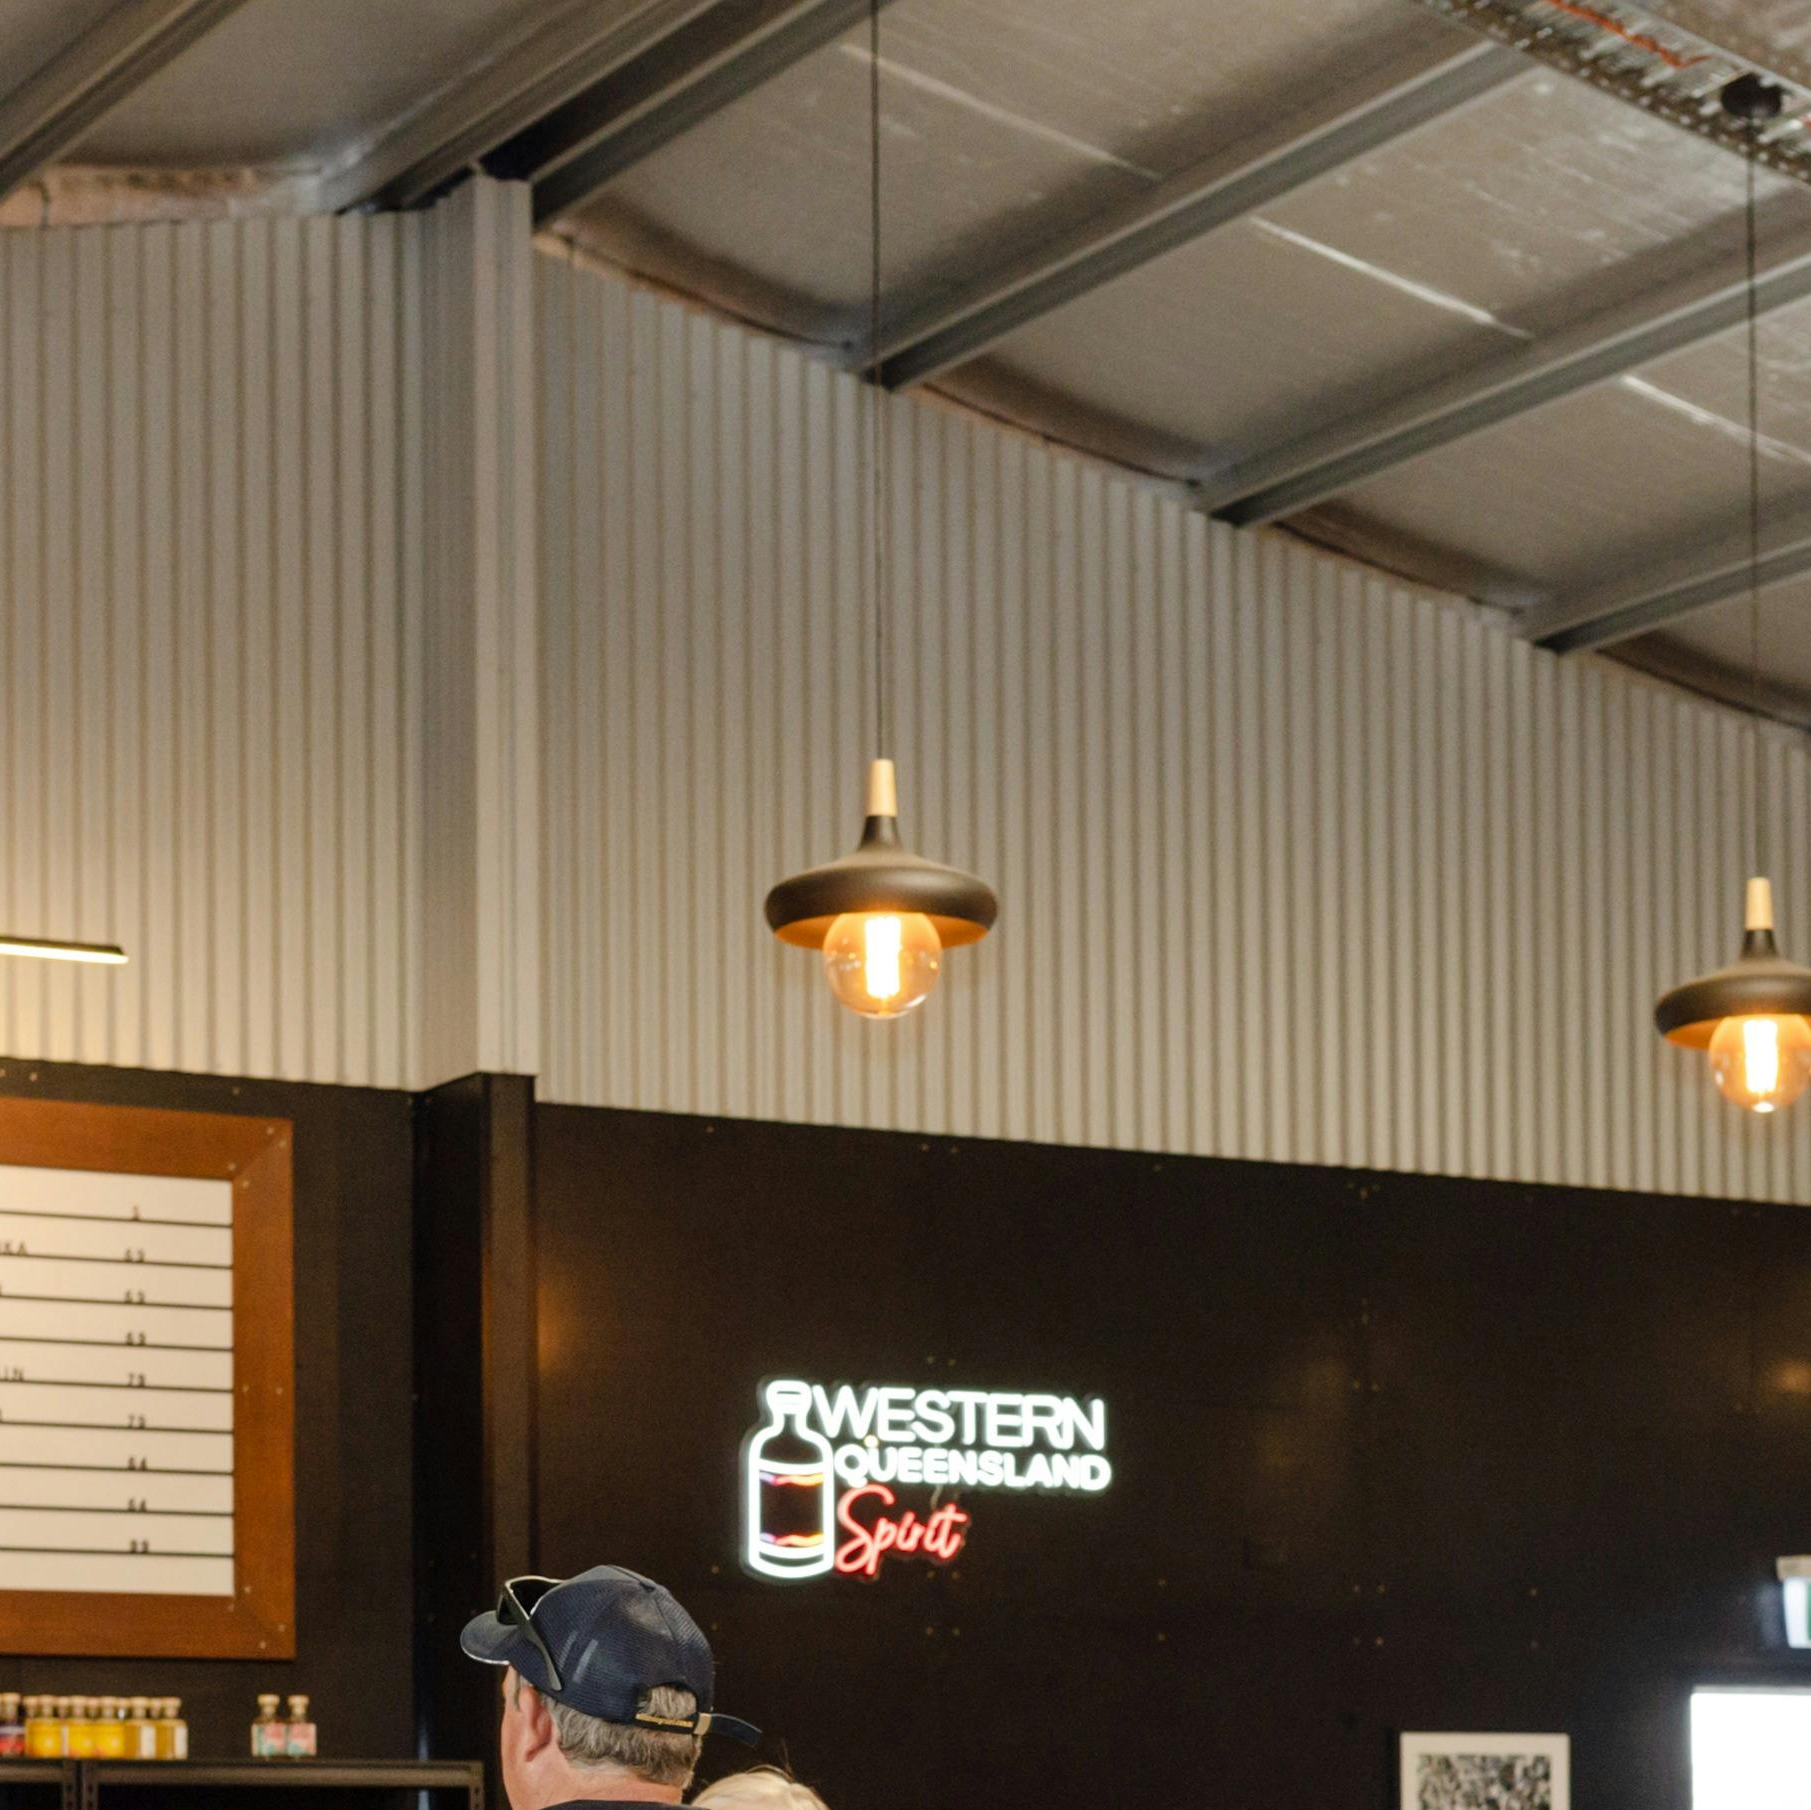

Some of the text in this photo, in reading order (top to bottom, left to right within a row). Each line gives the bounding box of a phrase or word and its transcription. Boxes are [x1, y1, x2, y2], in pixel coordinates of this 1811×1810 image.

[811, 1384, 1106, 1450] WESTERN
[833, 1442, 1112, 1492] QUEENSLAND
[835, 1483, 969, 1577] Spirit
